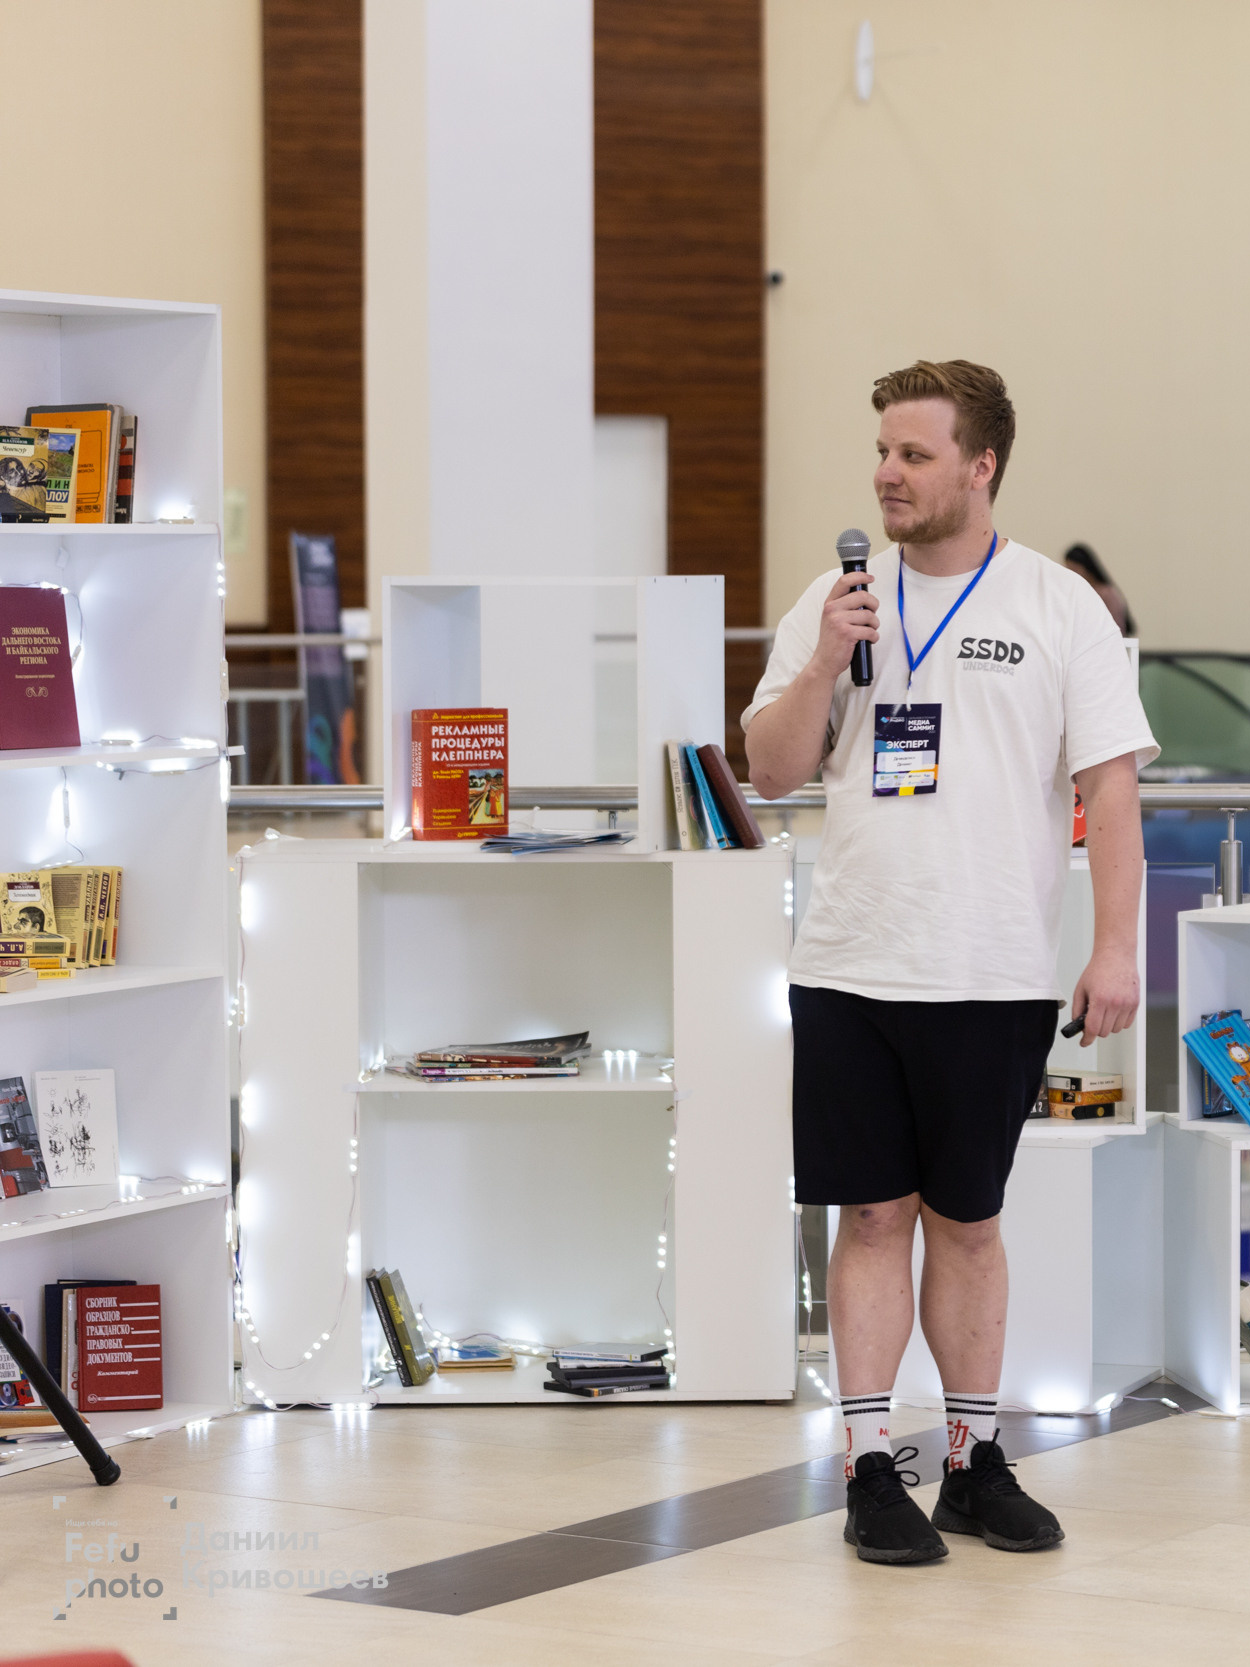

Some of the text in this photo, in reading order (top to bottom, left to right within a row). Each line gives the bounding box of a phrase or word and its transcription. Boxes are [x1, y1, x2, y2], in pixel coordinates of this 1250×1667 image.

[47, 480, 70, 489] ЛИН
[46, 491, 69, 502] АЛОУ
[11, 627, 50, 635] ЭКОНОМИКА
[2, 637, 61, 646] ДАЛЬНЕГО ВОСТОКА
[6, 646, 59, 655] И БАЙКАЛЬСКОГО
[957, 637, 1025, 665] SSDD
[20, 657, 48, 665] РЕГИОНА
[432, 725, 505, 736] РЕКЛАМНЫЕ
[432, 737, 504, 749] ПРОЦЕДУРЫ
[886, 740, 929, 750] ЭКСПЕРТ
[432, 750, 504, 762] КЛЕППНЕРА
[101, 874, 109, 900] ЧЕХОВ
[86, 1297, 117, 1308] СБОРНИК
[86, 1311, 121, 1323] ОБРАЗЦОВ
[86, 1325, 134, 1337] ГРАЖДАНСКО-
[87, 1338, 123, 1350] ПРАВОВЫХ
[87, 1352, 133, 1366] ДОКУМЕНТОВ
[97, 1369, 139, 1377] Комментарий
